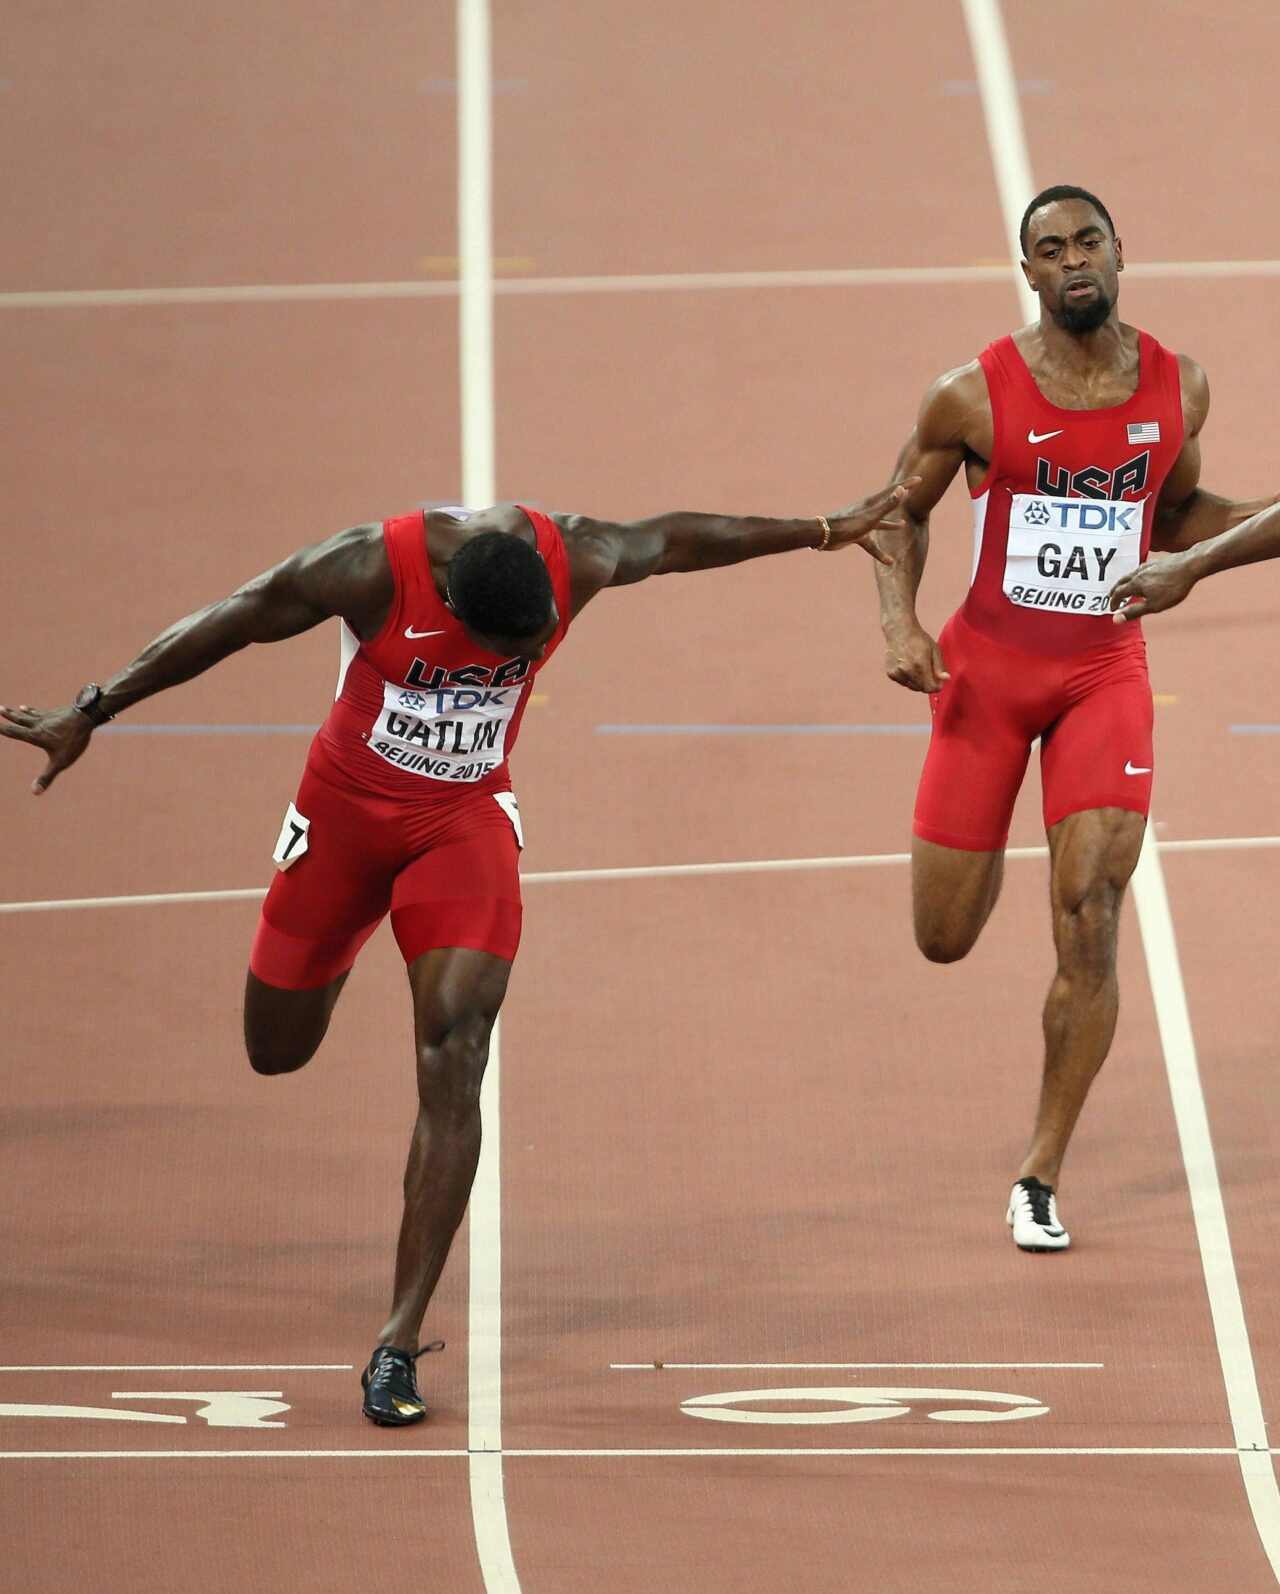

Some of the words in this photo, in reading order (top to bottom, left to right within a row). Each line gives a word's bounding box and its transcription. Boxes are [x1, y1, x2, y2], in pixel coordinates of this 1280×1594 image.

[1036, 450, 1149, 500] USA
[1051, 502, 1136, 531] TDK
[1037, 543, 1117, 582] GAY
[1010, 586, 1085, 609] BEIJING
[1088, 595, 1127, 611] 20
[404, 656, 531, 689] USA
[426, 689, 510, 714] TDK
[386, 712, 503, 755] GATLIN
[374, 742, 450, 777] BEIJING
[450, 762, 496, 779] 2015
[283, 820, 305, 860] 7
[681, 1388, 1050, 1424] 6
